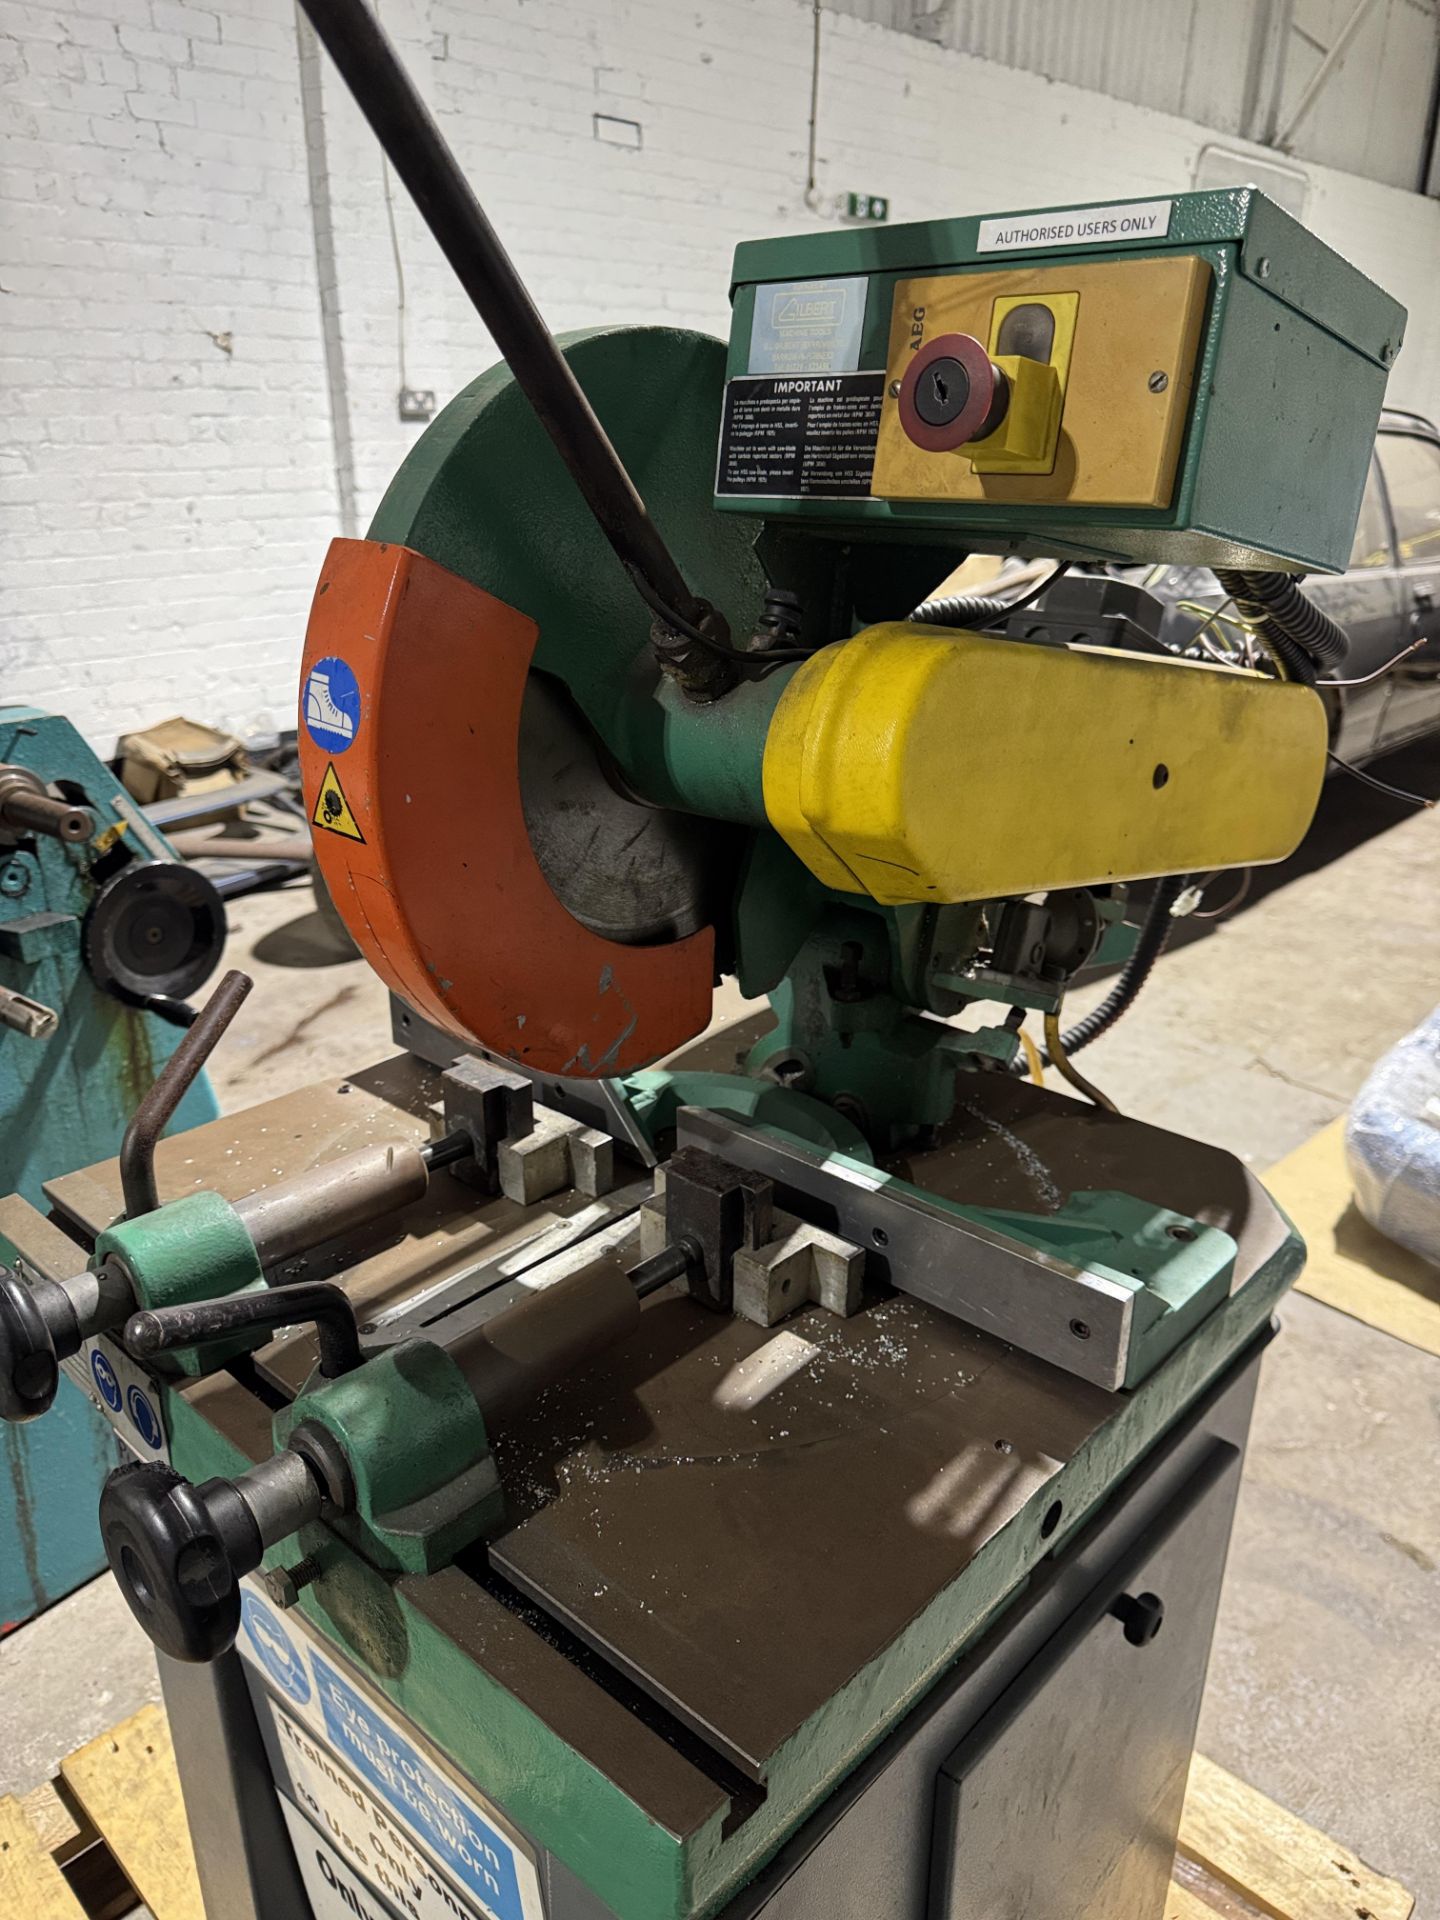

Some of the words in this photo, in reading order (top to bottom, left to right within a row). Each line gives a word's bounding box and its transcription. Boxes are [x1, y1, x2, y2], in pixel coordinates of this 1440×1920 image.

[995, 224, 1074, 245] AUTHORISED
[1077, 219, 1117, 237] USERS
[1120, 215, 1157, 232] ONLY
[910, 306, 926, 351] AEG
[773, 379, 843, 394] IMPORTANT
[278, 1713, 368, 1815] Trained
[328, 1682, 371, 1737] Eye
[375, 1733, 500, 1871] protection
[296, 1781, 320, 1814] to
[324, 1809, 369, 1866] Use
[374, 1862, 421, 1920] this
[341, 1722, 398, 1790] must
[400, 1777, 432, 1823] be
[434, 1817, 500, 1897] worn
[368, 1832, 422, 1901] Only
